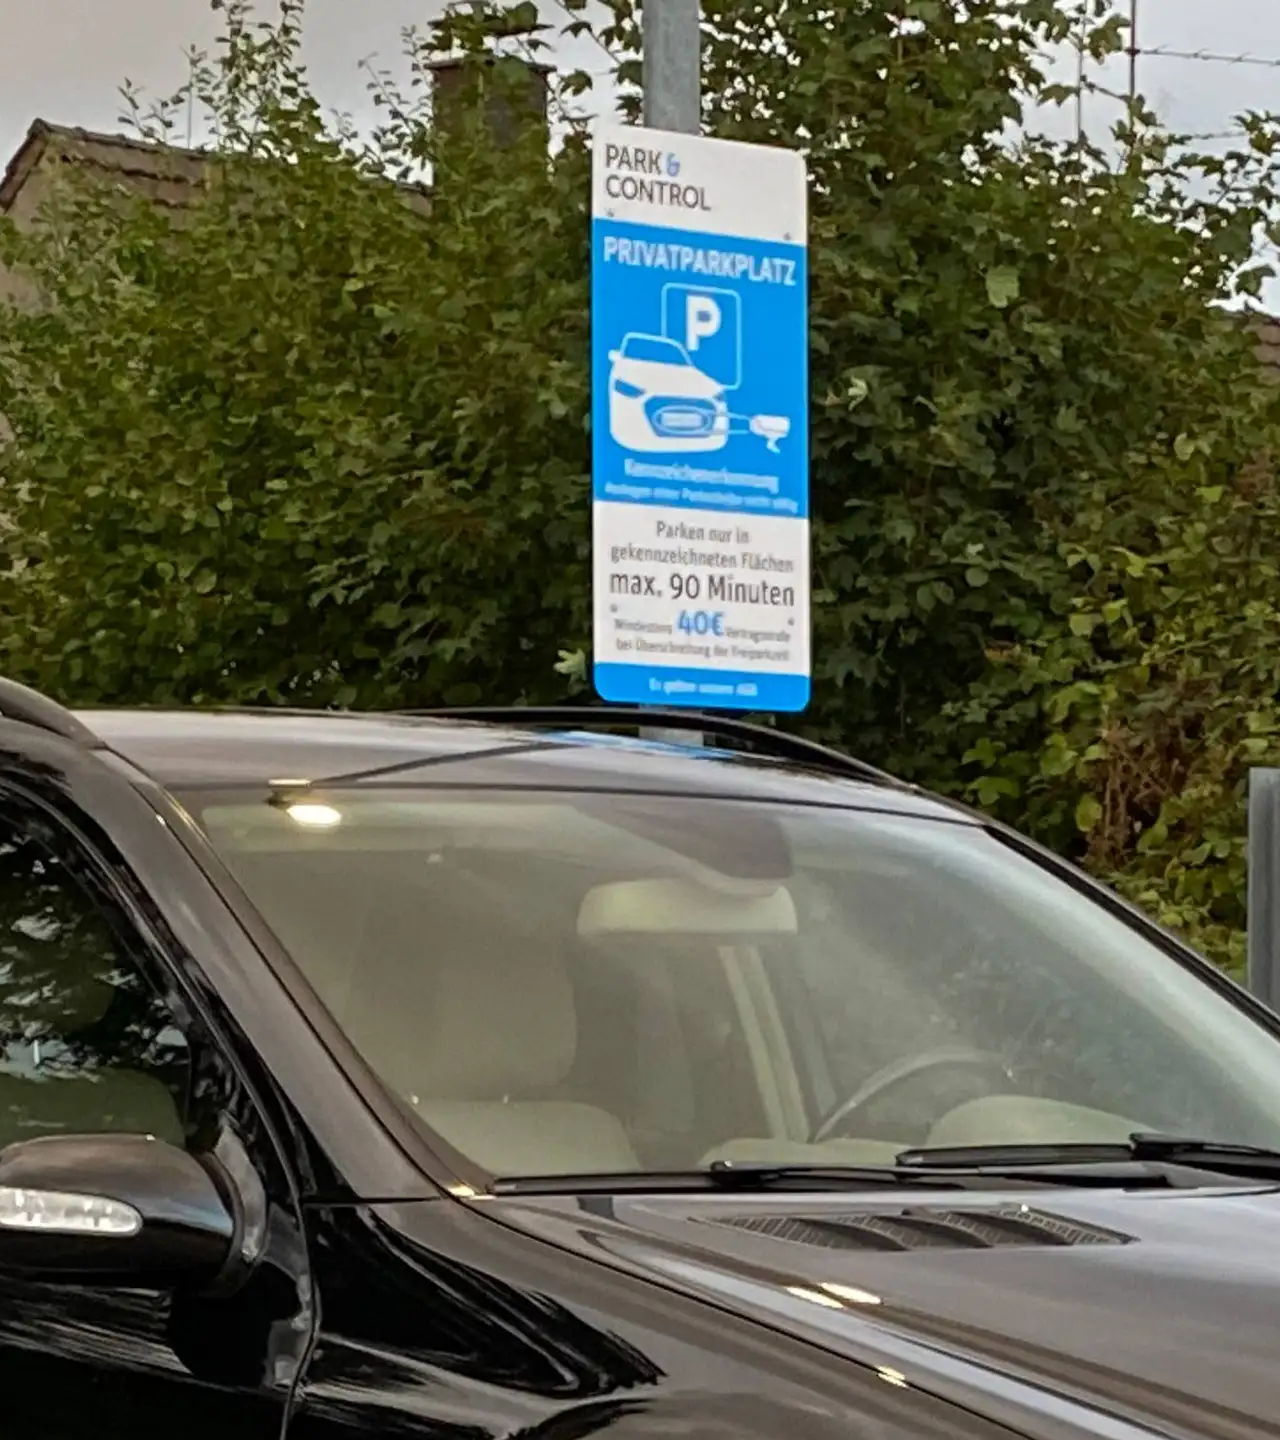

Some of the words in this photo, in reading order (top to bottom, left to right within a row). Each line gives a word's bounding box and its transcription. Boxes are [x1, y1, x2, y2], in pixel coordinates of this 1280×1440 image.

[605, 144, 662, 175] PARK
[605, 174, 711, 211] CONTROL
[603, 236, 797, 286] PRIVATPARKPLATZ
[685, 294, 722, 352] P
[656, 520, 705, 542] Parken
[708, 528, 732, 543] nur
[736, 527, 750, 543] in
[610, 542, 737, 568] gekennzeichneten
[741, 552, 794, 574] Flächen
[609, 571, 663, 598] max.
[669, 572, 701, 600] 90
[707, 573, 795, 606] Minuten
[676, 610, 726, 637] 40€
